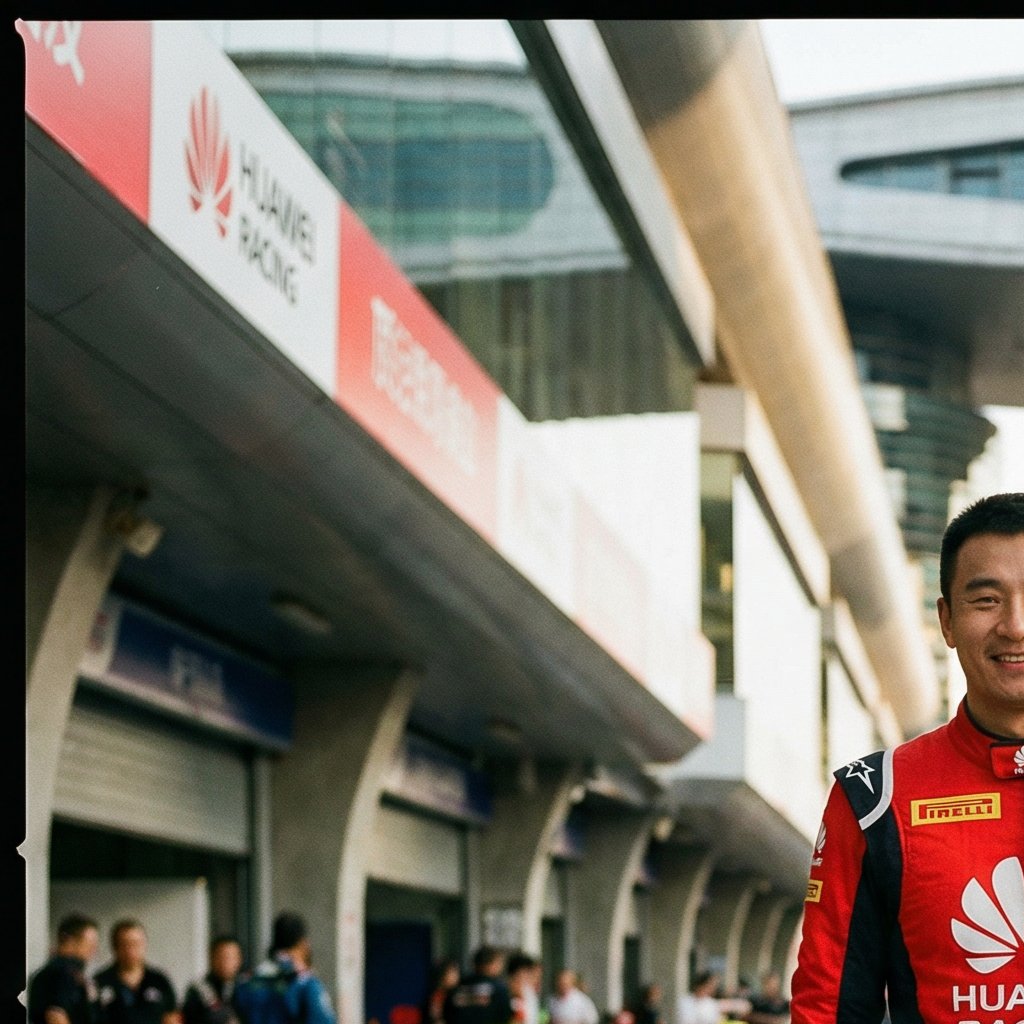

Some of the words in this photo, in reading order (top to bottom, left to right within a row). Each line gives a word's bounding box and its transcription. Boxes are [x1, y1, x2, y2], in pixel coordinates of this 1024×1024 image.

[239, 142, 317, 267] HUAWEI
[239, 214, 297, 306] RACING
[918, 798, 993, 820] PIRELLI
